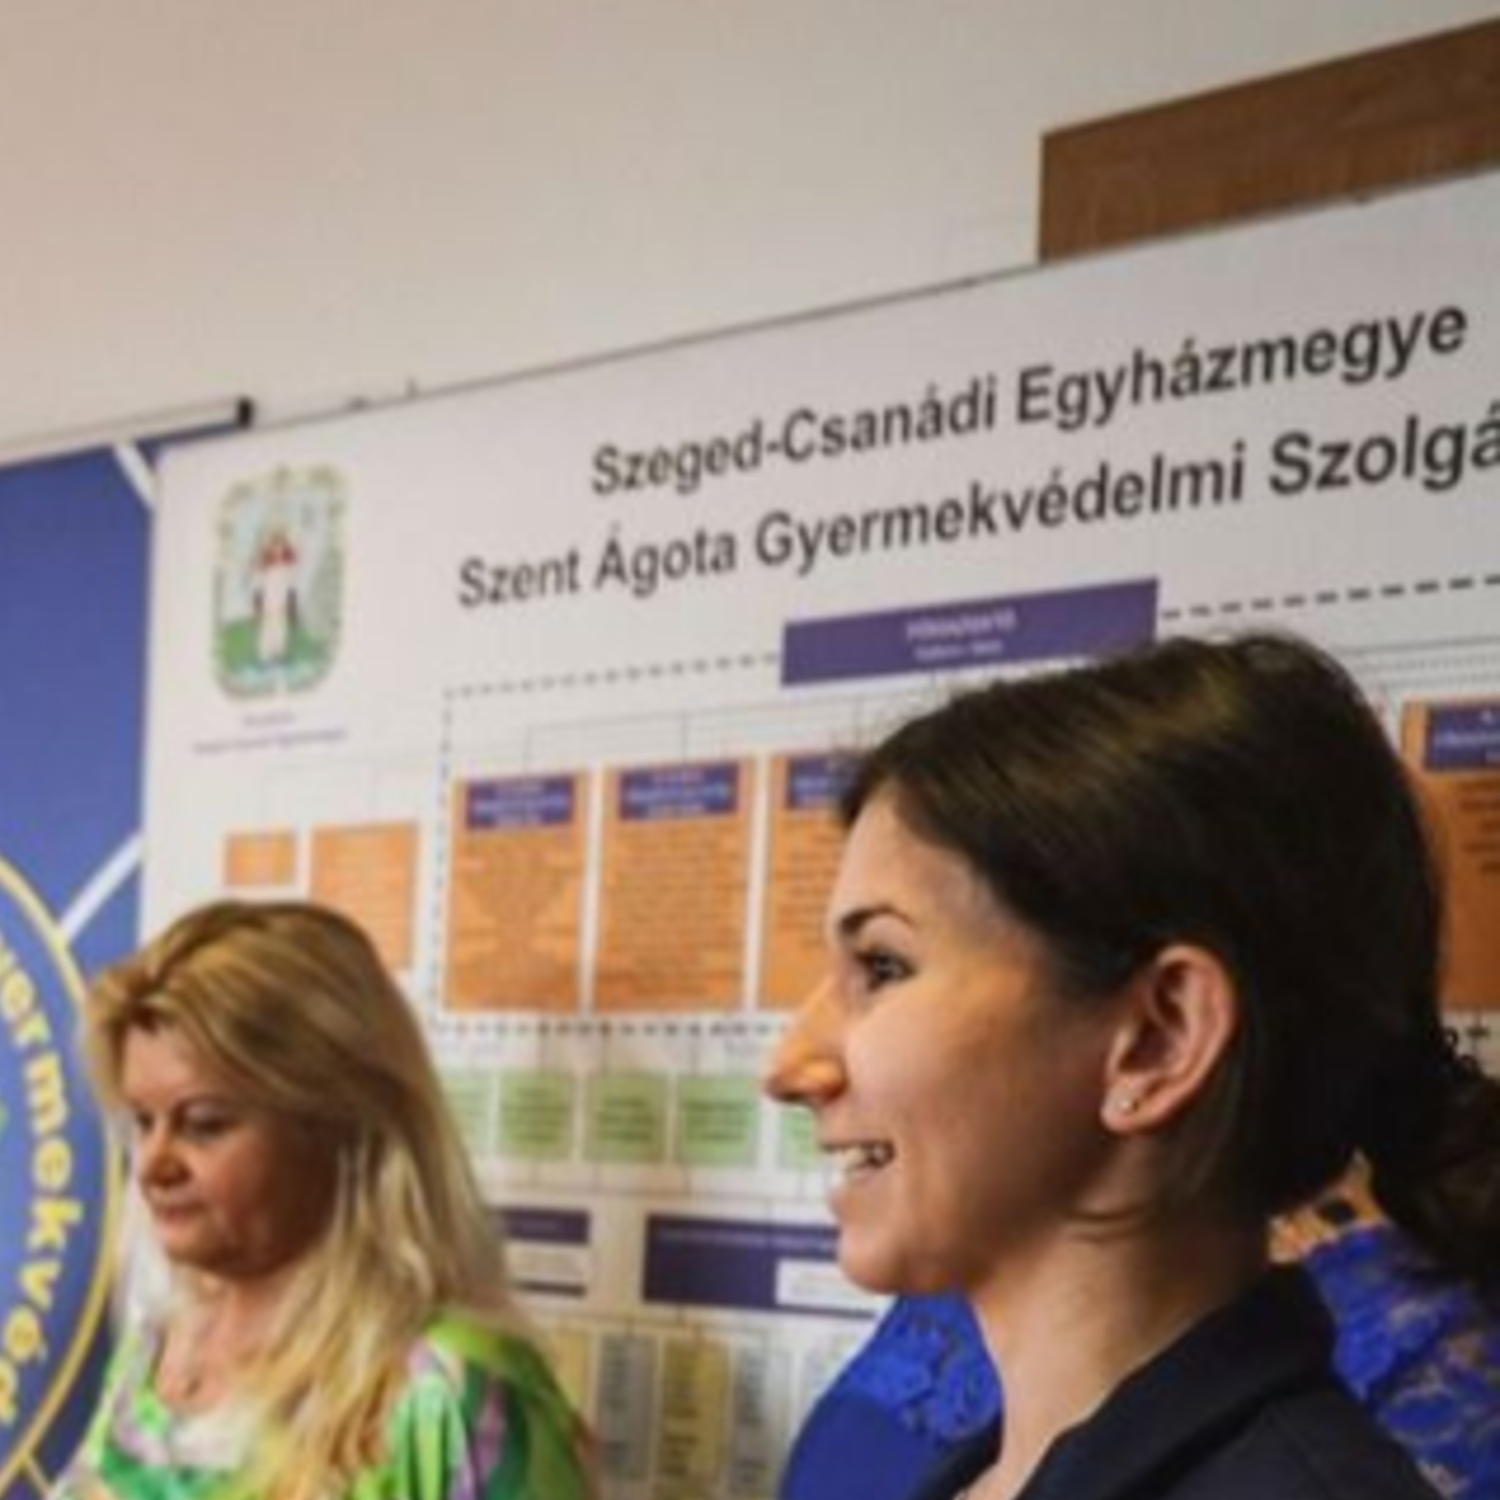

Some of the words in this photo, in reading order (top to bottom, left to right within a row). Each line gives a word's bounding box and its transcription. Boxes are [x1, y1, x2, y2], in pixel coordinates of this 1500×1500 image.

[590, 372, 997, 496] Szeged-Csanádi
[1016, 304, 1467, 431] Egyházmegye
[457, 548, 581, 608] Szent
[594, 522, 738, 600] Ágota
[755, 439, 1247, 577] Gyermekvédelmi
[1268, 398, 1500, 496] Szolgá
